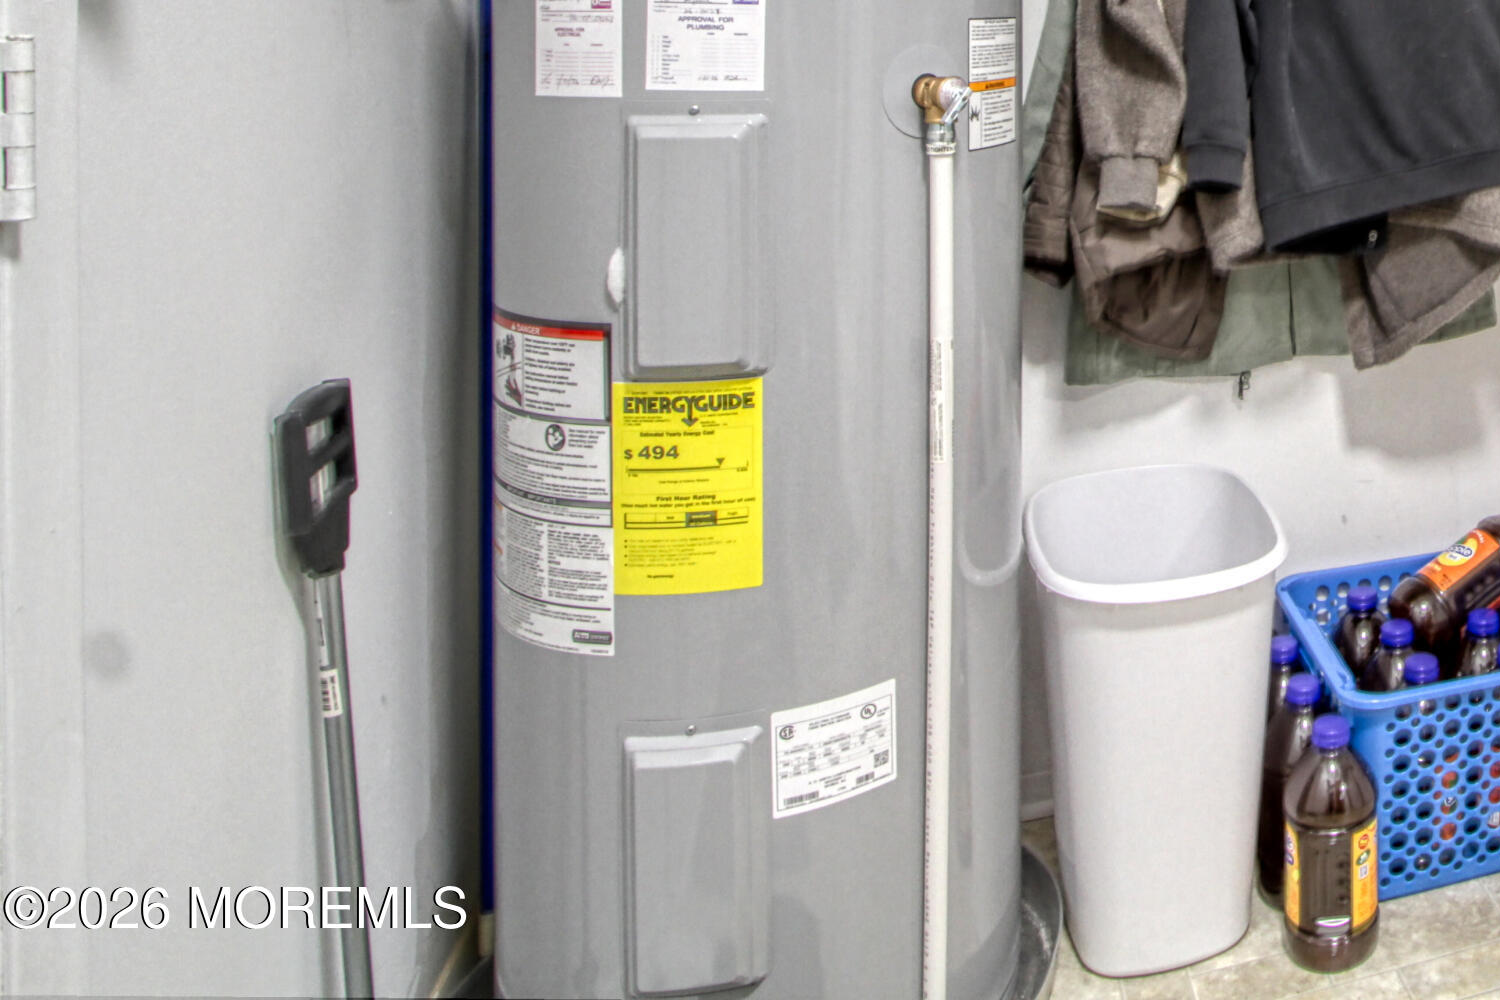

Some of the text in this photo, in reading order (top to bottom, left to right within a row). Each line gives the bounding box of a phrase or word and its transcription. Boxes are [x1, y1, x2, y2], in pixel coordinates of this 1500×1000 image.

[516, 323, 541, 335] DANGER
[623, 391, 756, 417] ENERGYGUIDE
[624, 445, 680, 460] $ 494
